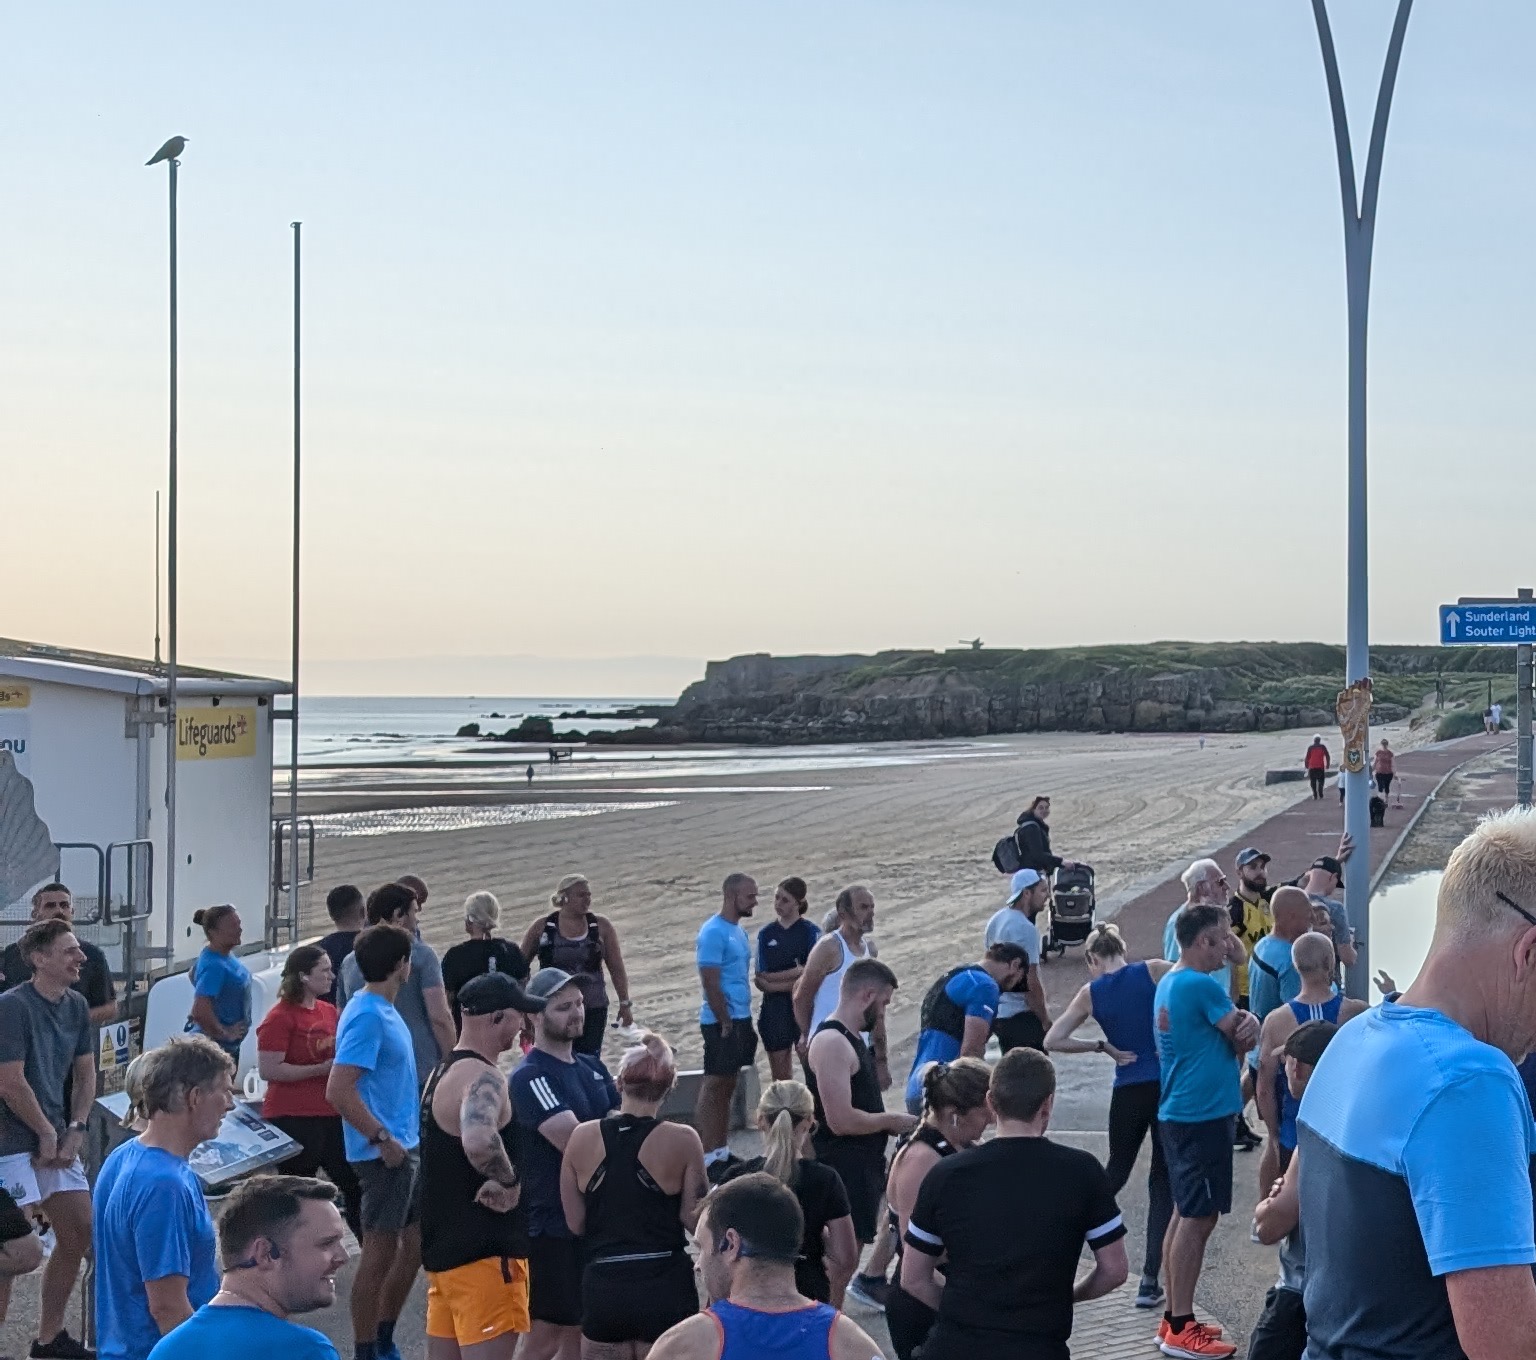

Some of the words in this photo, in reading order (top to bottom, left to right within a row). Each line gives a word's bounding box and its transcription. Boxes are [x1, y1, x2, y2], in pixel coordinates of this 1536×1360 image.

[1465, 611, 1530, 622] Sunderland
[1465, 626, 1504, 637] Souter
[179, 716, 236, 756] Lifeguards
